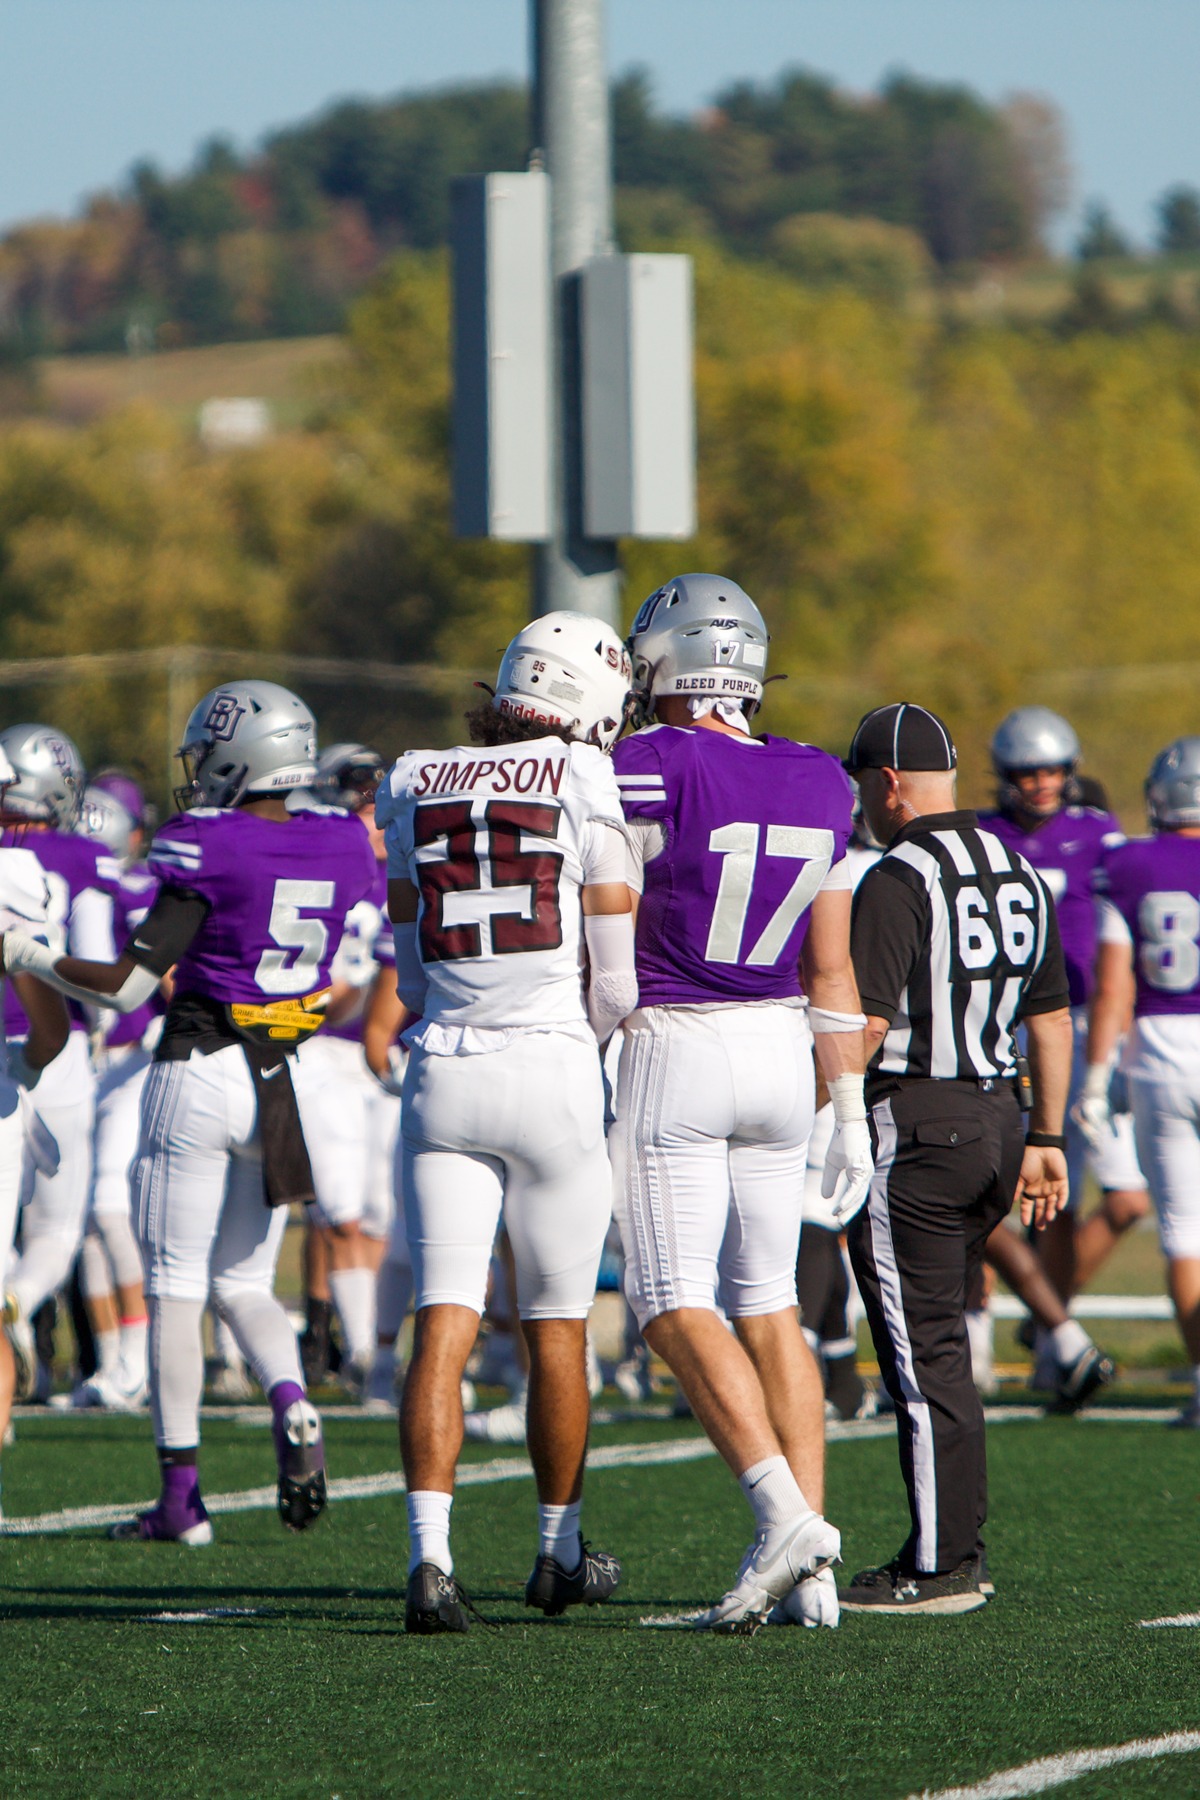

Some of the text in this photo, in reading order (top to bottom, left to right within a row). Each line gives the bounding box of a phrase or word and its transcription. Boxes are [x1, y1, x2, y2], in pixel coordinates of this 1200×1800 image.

[532, 660, 546, 672] 25
[713, 640, 740, 665] 17
[675, 678, 758, 695] BLEED PURPLE
[203, 692, 247, 742] BU
[413, 757, 565, 796] SIMPSON
[413, 799, 564, 963] 25
[705, 821, 835, 966] 17
[253, 878, 335, 995] 5
[955, 882, 1035, 970] 66
[1138, 891, 1200, 993] 8
[232, 1008, 254, 1018] CRIME
